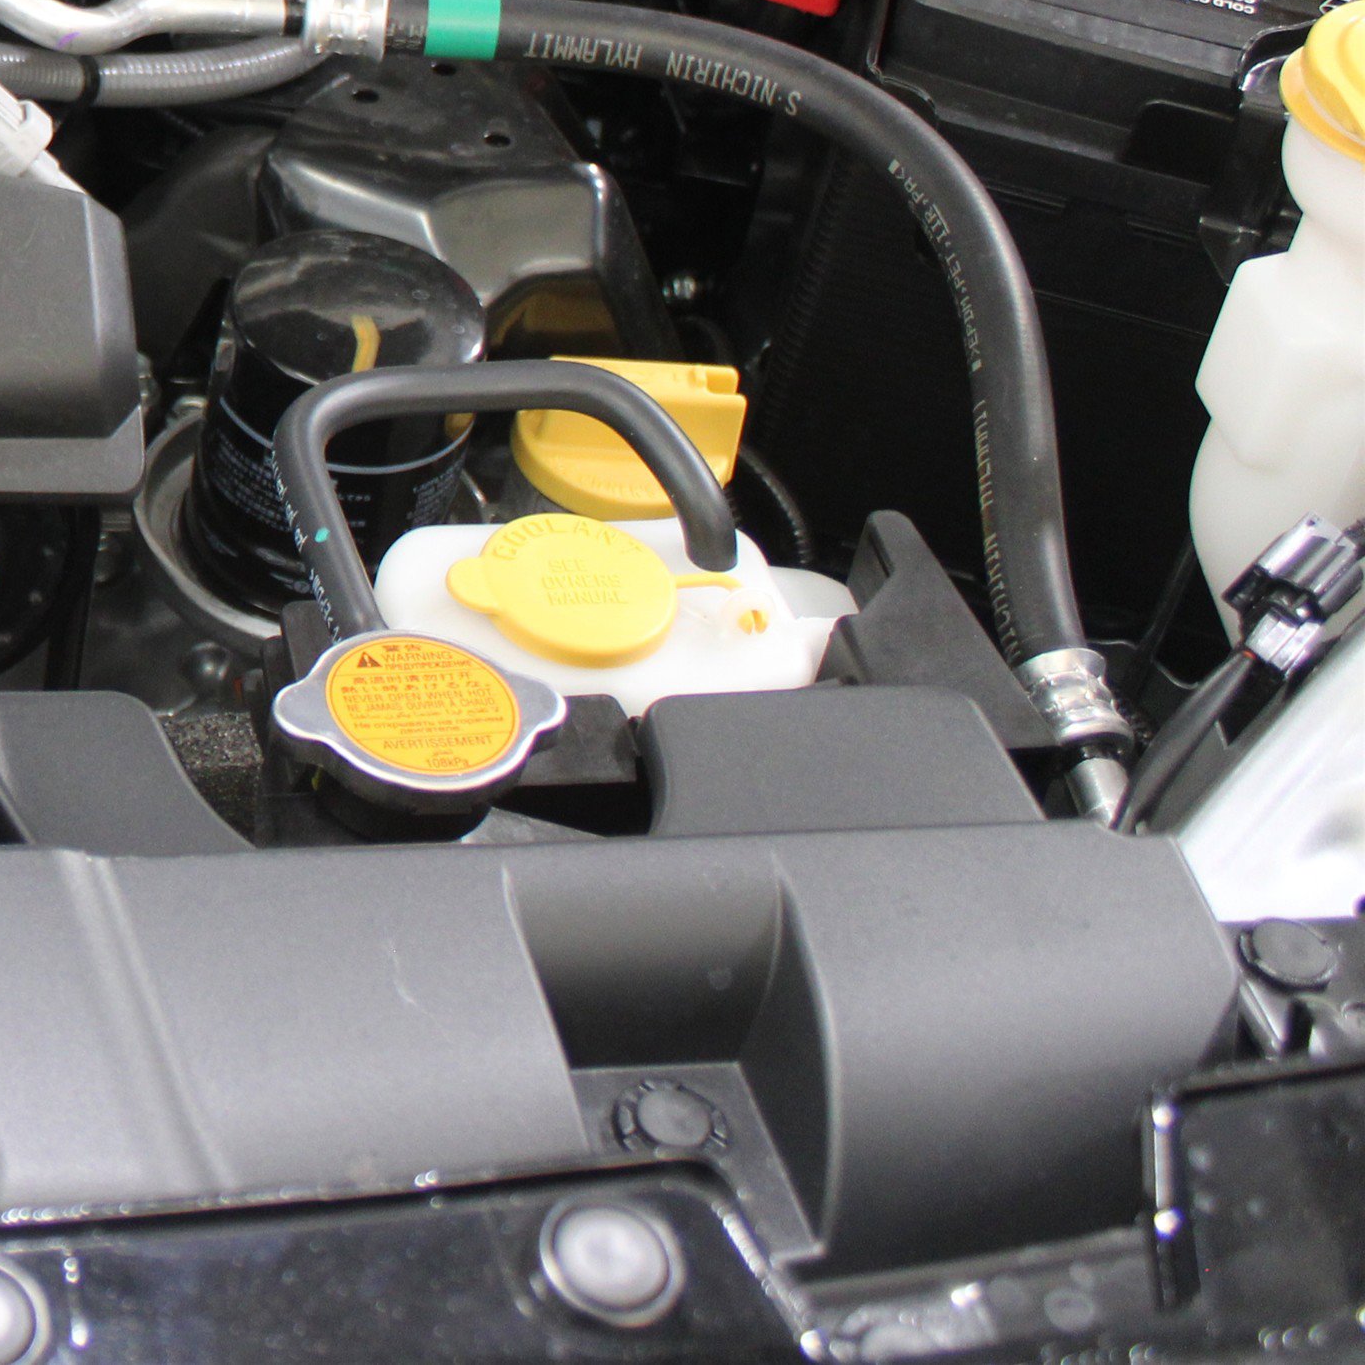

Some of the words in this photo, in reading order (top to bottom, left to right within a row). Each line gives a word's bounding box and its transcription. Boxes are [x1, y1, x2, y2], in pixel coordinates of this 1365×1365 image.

[492, 518, 645, 561] COOLANT
[548, 557, 588, 573] SEE
[547, 590, 630, 605] MANUAL
[381, 650, 453, 663] WARNING
[343, 694, 384, 704] NEVER
[388, 692, 422, 702] OPEN
[426, 690, 464, 700] WHEN
[467, 688, 493, 697] HOT
[347, 703, 362, 713] NE
[366, 702, 404, 712] JAMAIS
[406, 700, 445, 710] OUVRIR
[460, 697, 495, 708] CHAUD
[382, 735, 493, 750] AVERTISSEMENT
[426, 757, 470, 768] 108kPa
